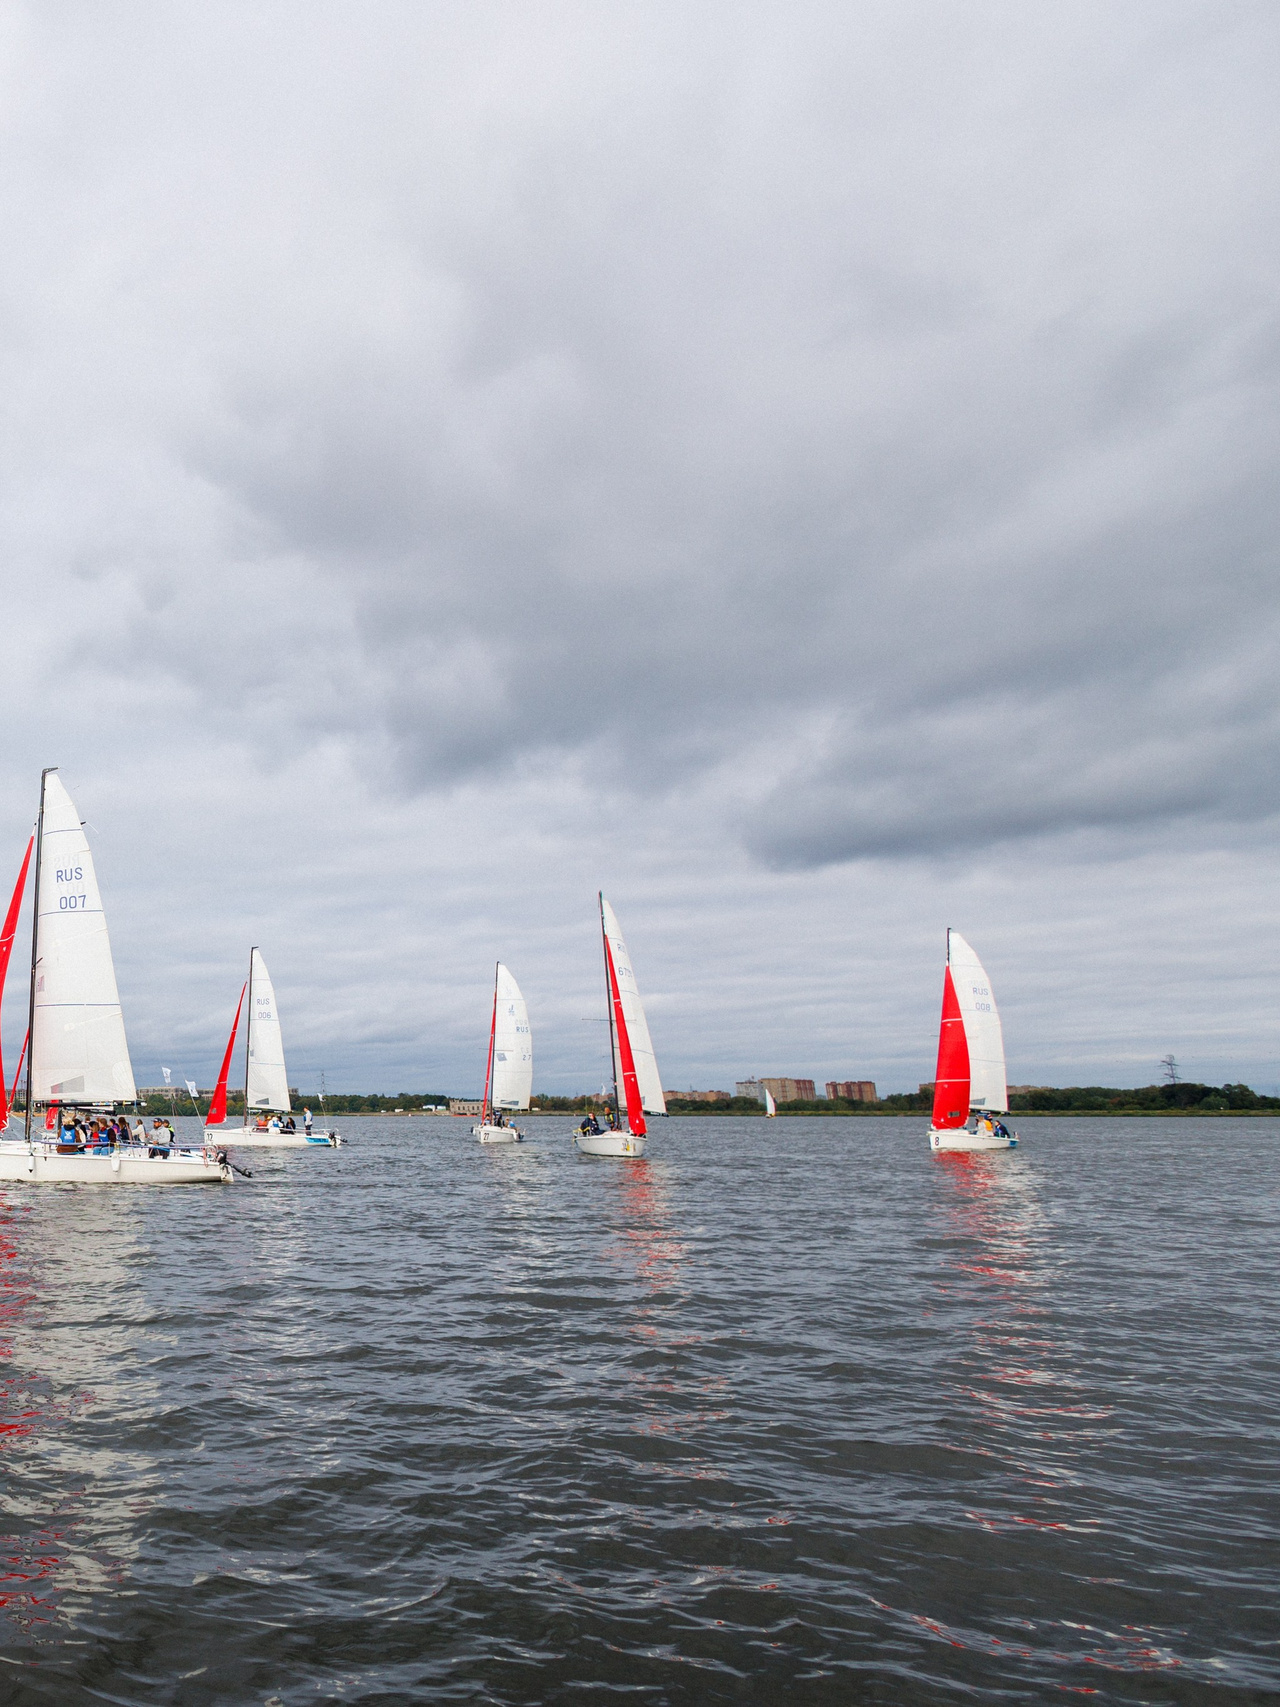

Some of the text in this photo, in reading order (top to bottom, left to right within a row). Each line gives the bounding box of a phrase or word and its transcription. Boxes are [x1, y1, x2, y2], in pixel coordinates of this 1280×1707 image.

[56, 867, 83, 883] RUS
[59, 894, 87, 910] 007
[972, 987, 989, 996] RUS
[256, 998, 270, 1006] RUS
[257, 1011, 272, 1019] 006
[934, 1136, 940, 1146] 8
